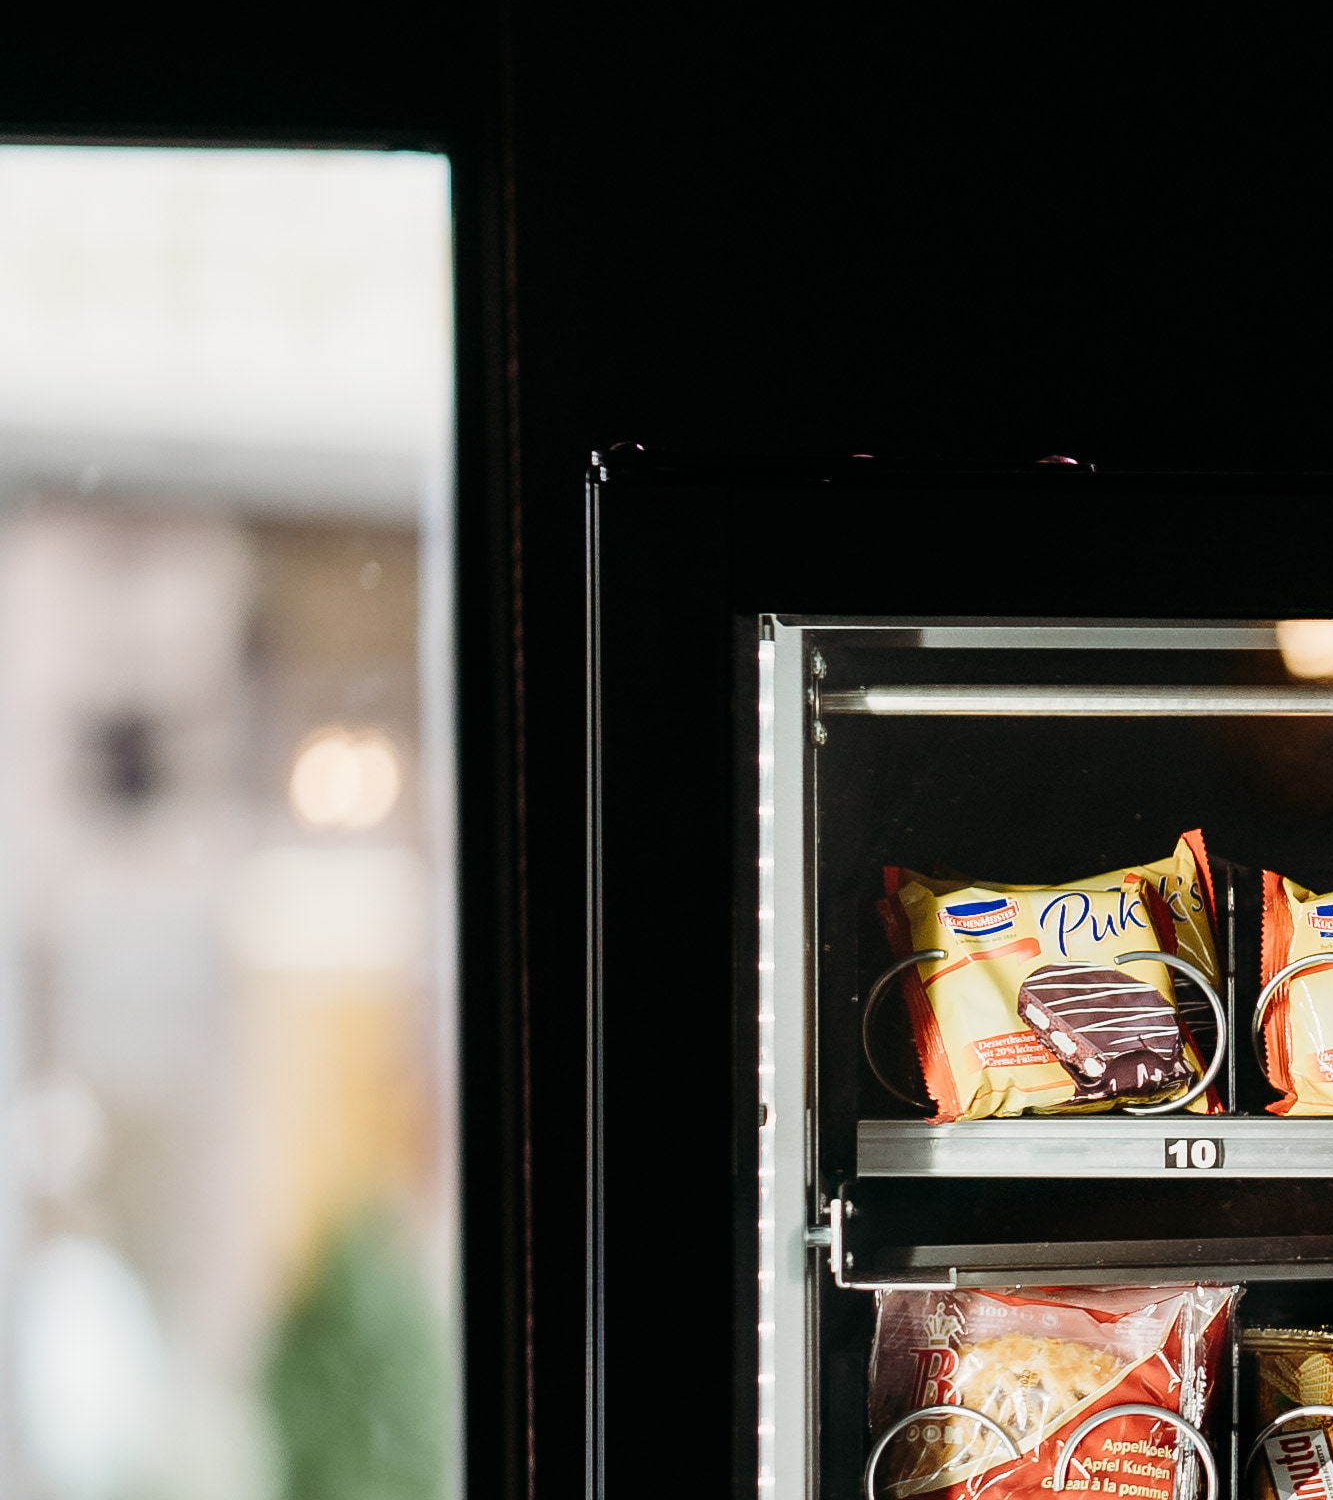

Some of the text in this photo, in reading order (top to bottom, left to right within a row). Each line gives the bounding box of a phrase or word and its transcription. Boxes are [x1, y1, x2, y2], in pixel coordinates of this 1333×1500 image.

[1168, 1140, 1217, 1169] 10
[1101, 1438, 1173, 1460] Appelkoek
[1082, 1457, 1171, 1481] Apfel Kuchen
[1041, 1476, 1089, 1491] Geau
[1103, 1477, 1117, 1494] la
